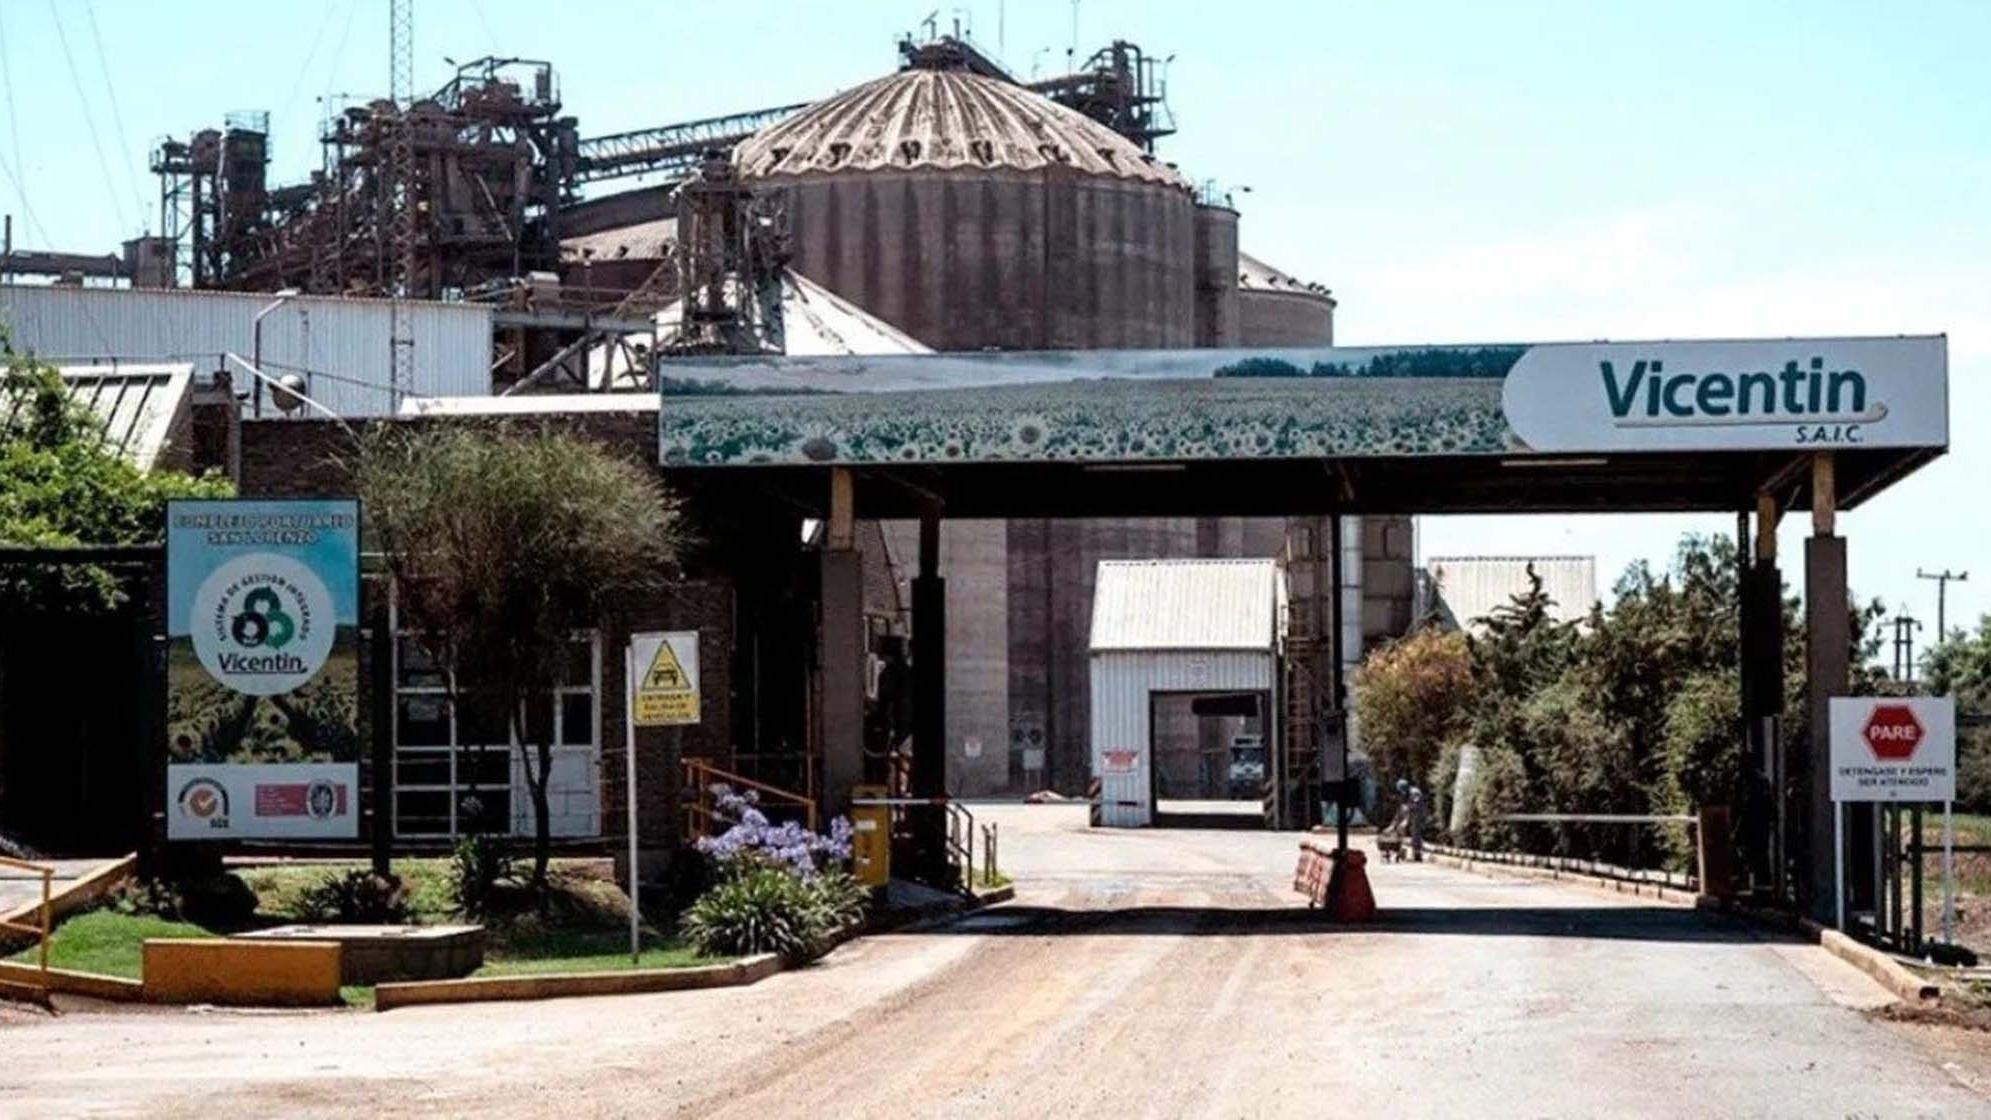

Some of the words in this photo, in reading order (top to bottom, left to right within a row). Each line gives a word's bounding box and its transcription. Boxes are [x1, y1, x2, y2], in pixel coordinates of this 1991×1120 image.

[1600, 356, 1866, 418] Vicentin
[1796, 425, 1863, 443] S.A.I.C.
[218, 652, 303, 672] Vicentin
[1869, 725, 1916, 740] PARE
